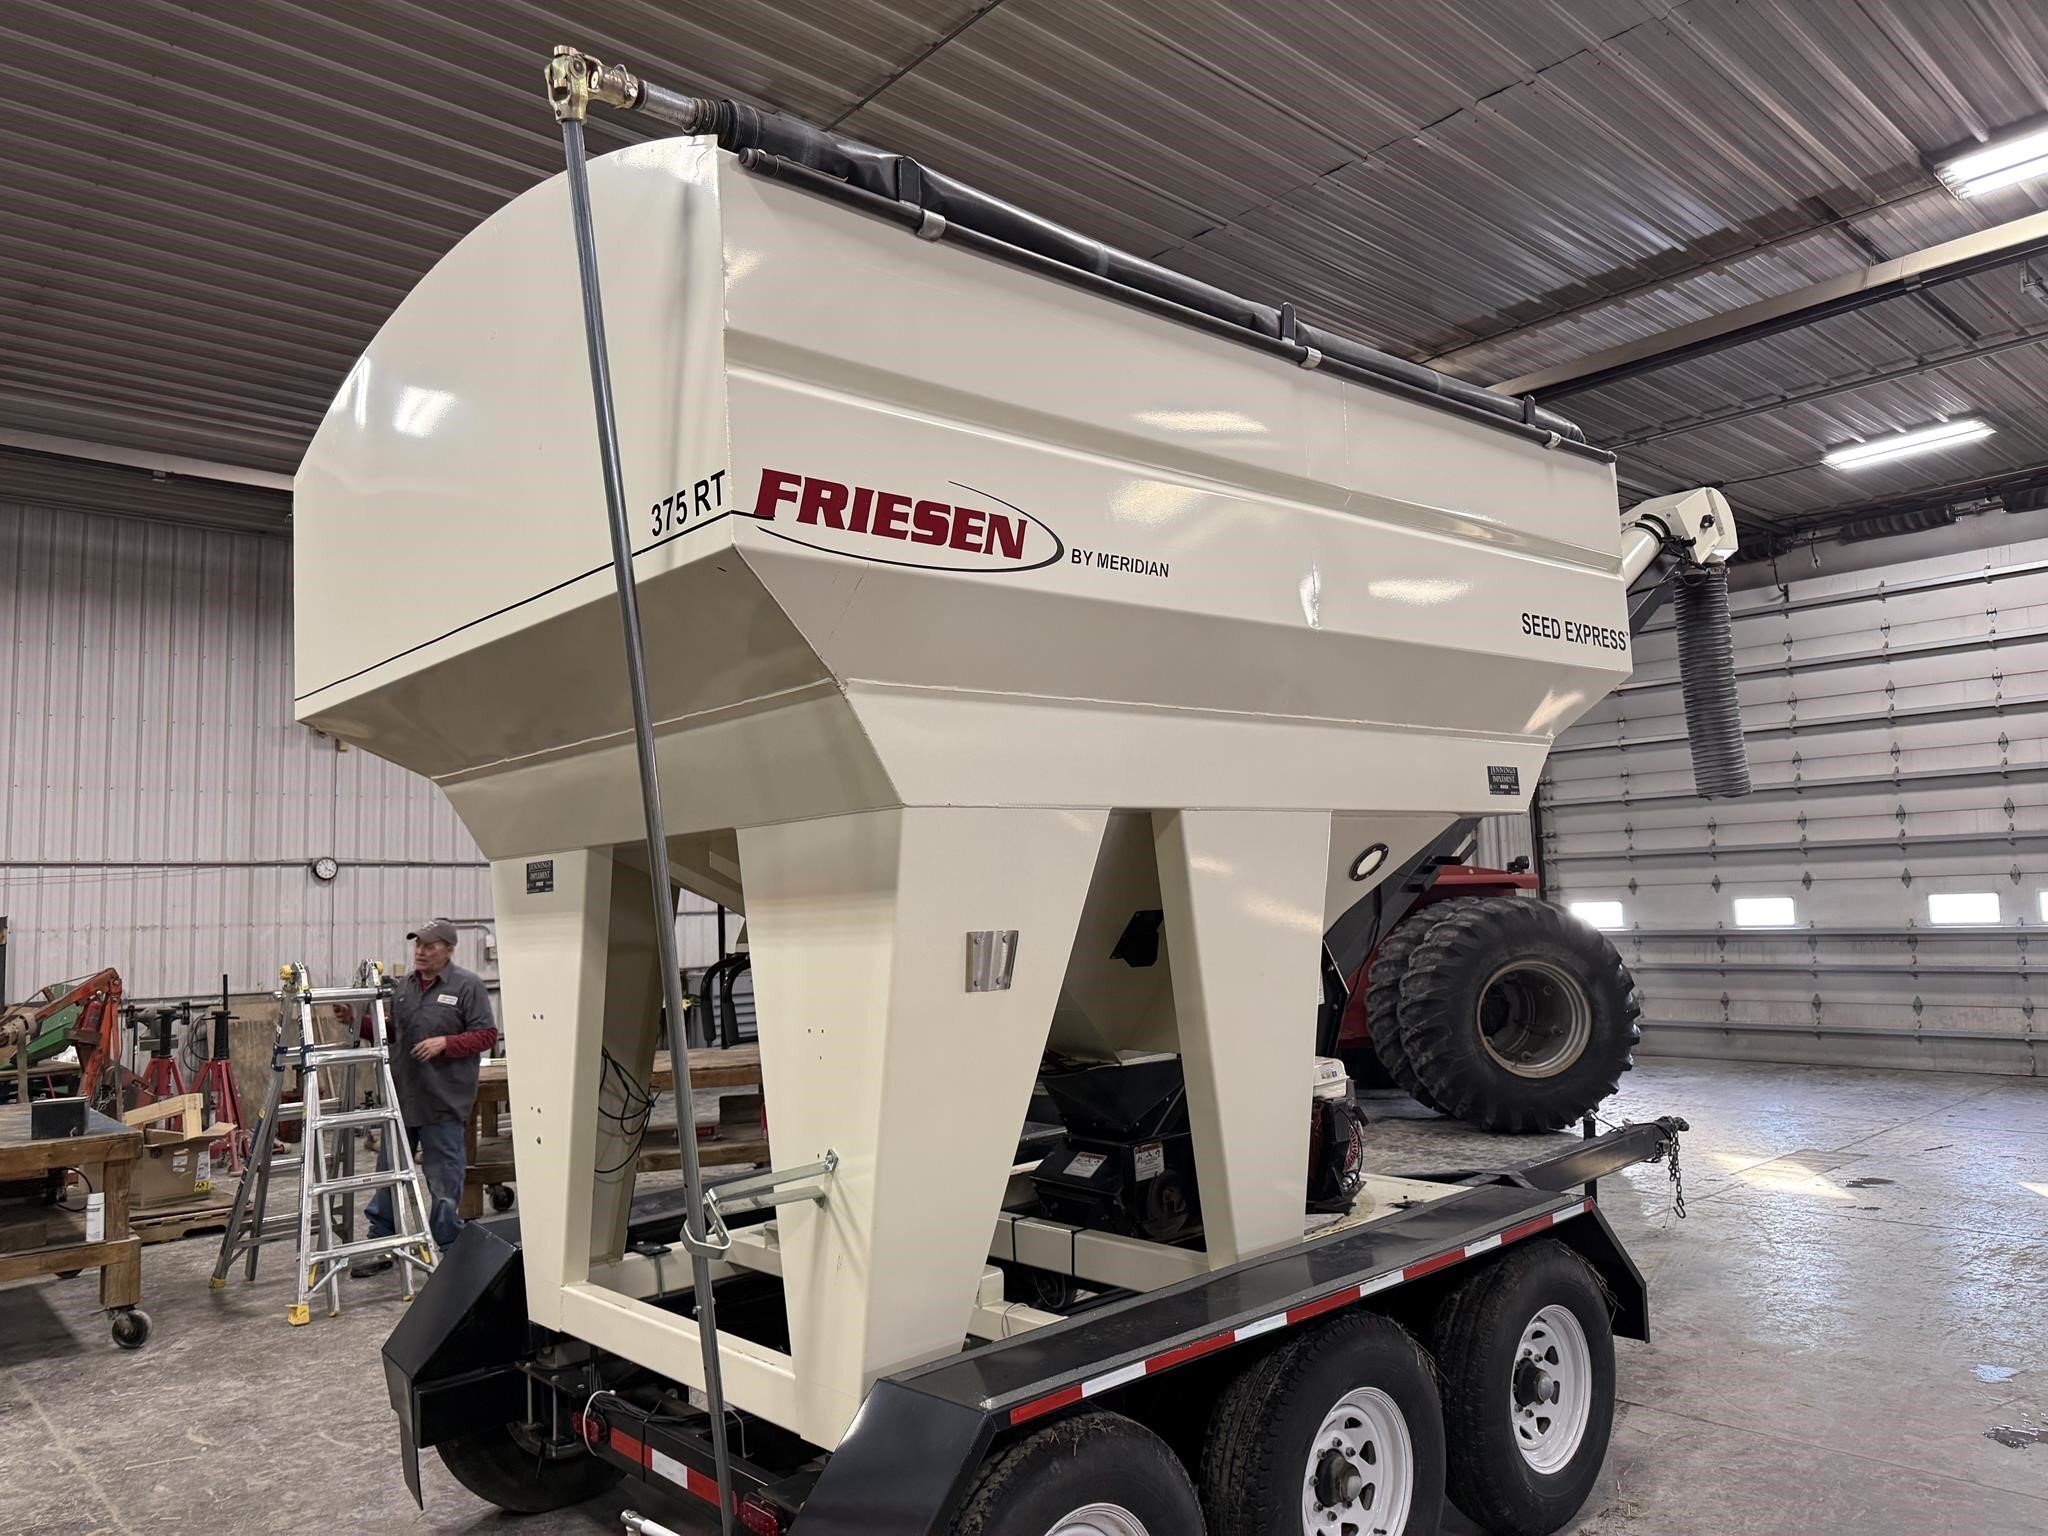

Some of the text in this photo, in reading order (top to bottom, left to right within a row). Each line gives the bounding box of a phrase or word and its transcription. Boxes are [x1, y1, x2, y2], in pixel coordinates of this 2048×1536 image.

[651, 469, 725, 537] 375 RT
[753, 468, 1027, 559] FRIESEN
[1071, 548, 1169, 578] BY MERIDIAN
[1521, 612, 1627, 651] SEED EXPRESS
